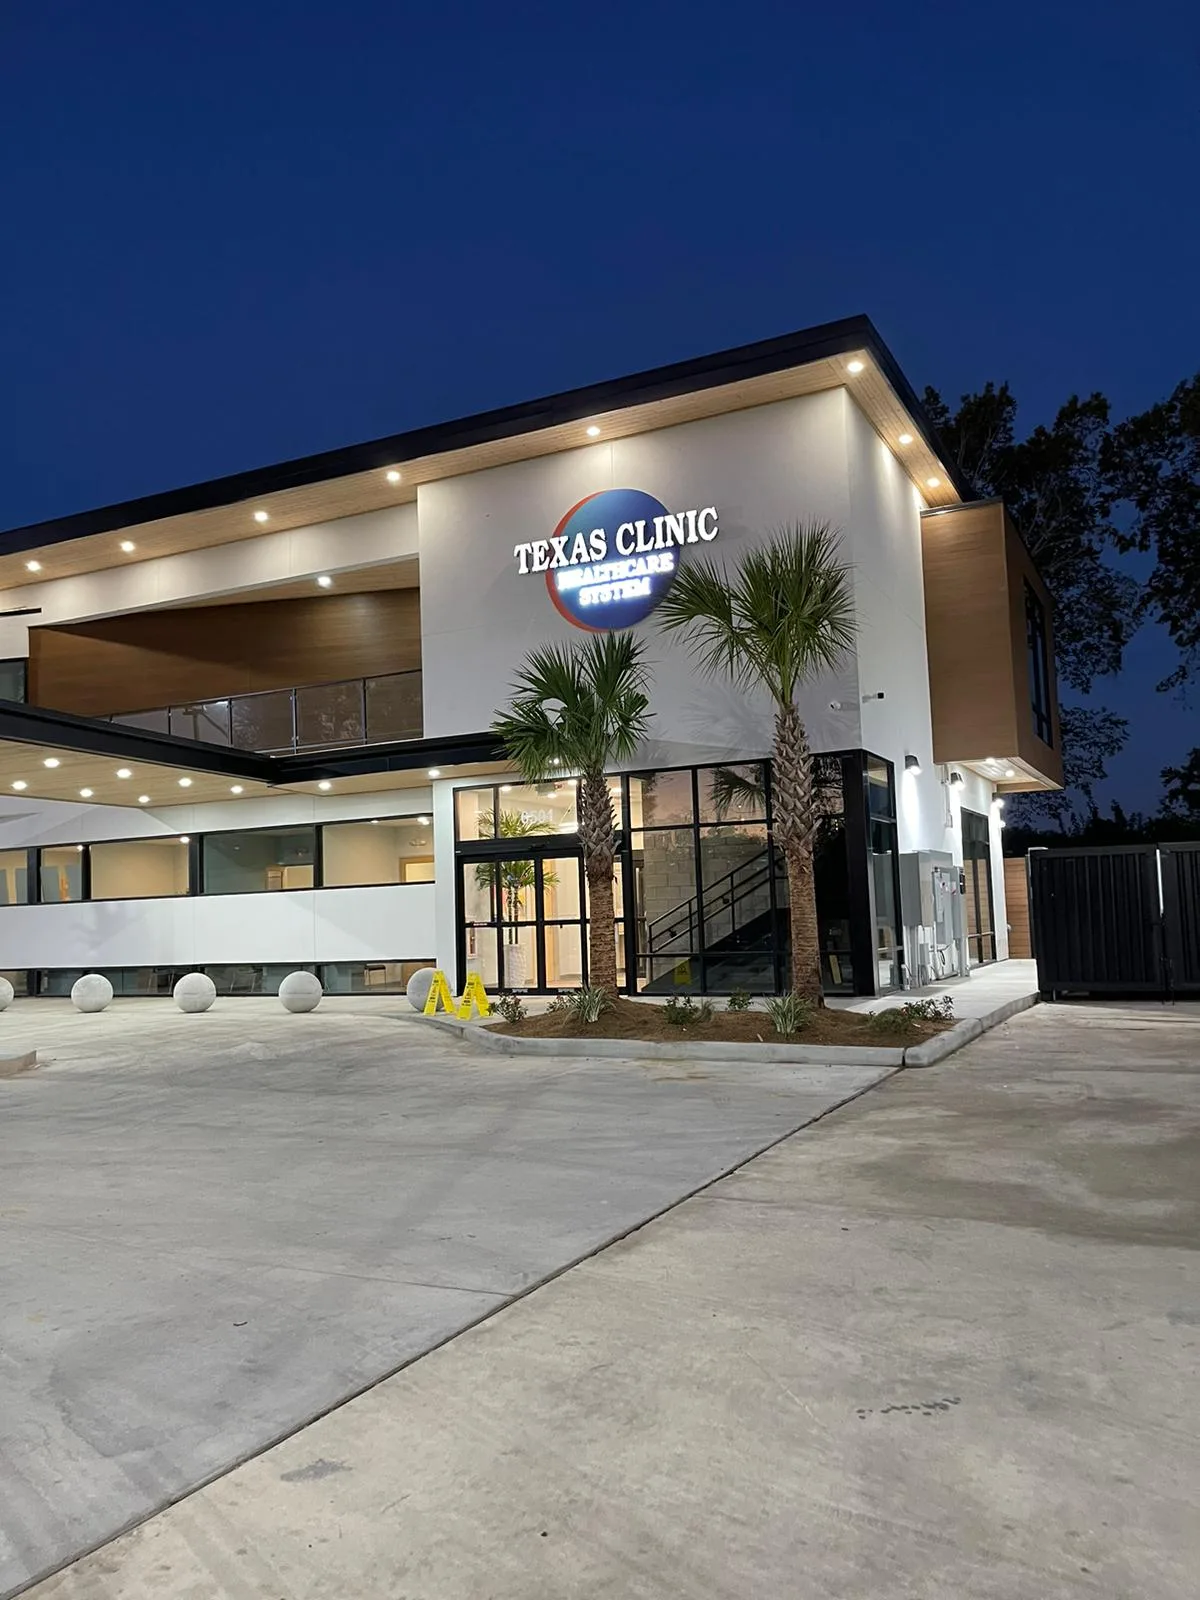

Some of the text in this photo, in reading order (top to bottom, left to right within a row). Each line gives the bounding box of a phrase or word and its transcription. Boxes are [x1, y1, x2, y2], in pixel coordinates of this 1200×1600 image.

[514, 507, 718, 575] TEXAS CLINIC
[579, 577, 651, 606] SYSTEM
